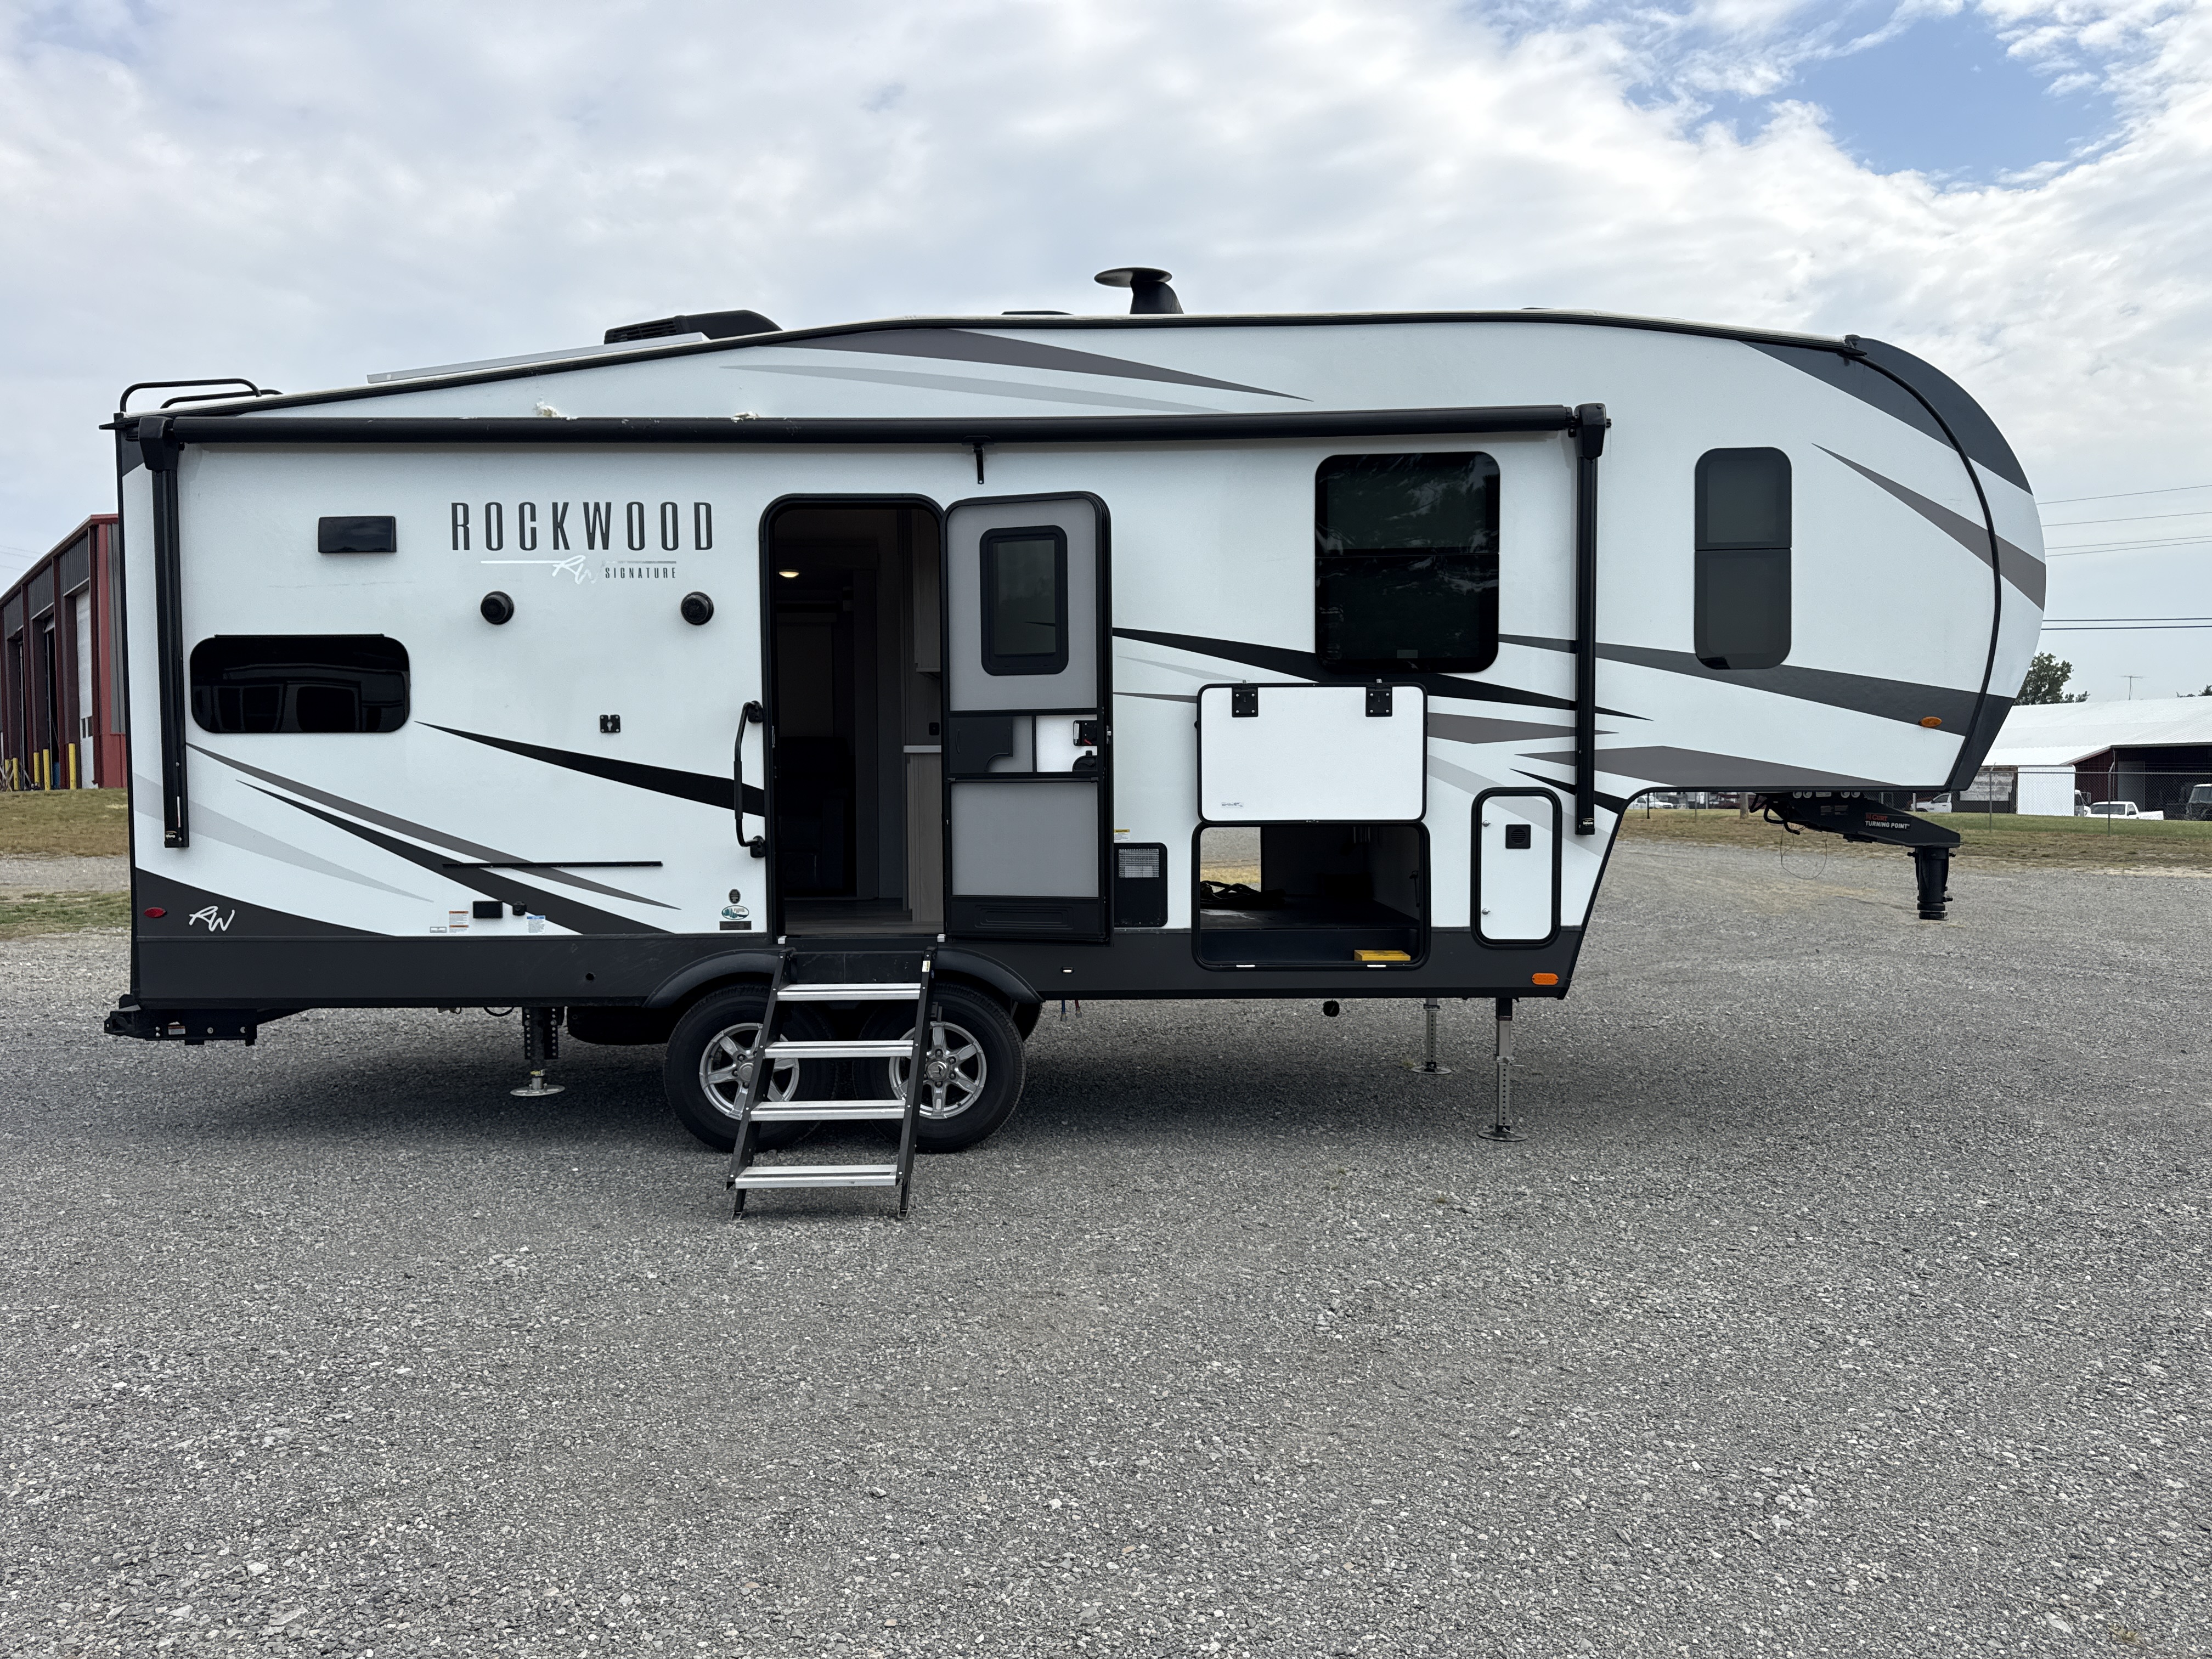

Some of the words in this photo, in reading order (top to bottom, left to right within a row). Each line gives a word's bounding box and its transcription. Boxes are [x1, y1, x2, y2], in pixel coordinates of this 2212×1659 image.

[451, 501, 713, 551] ROCKWOOD
[605, 567, 676, 579] SIGNATURE
[189, 905, 235, 932] RW
